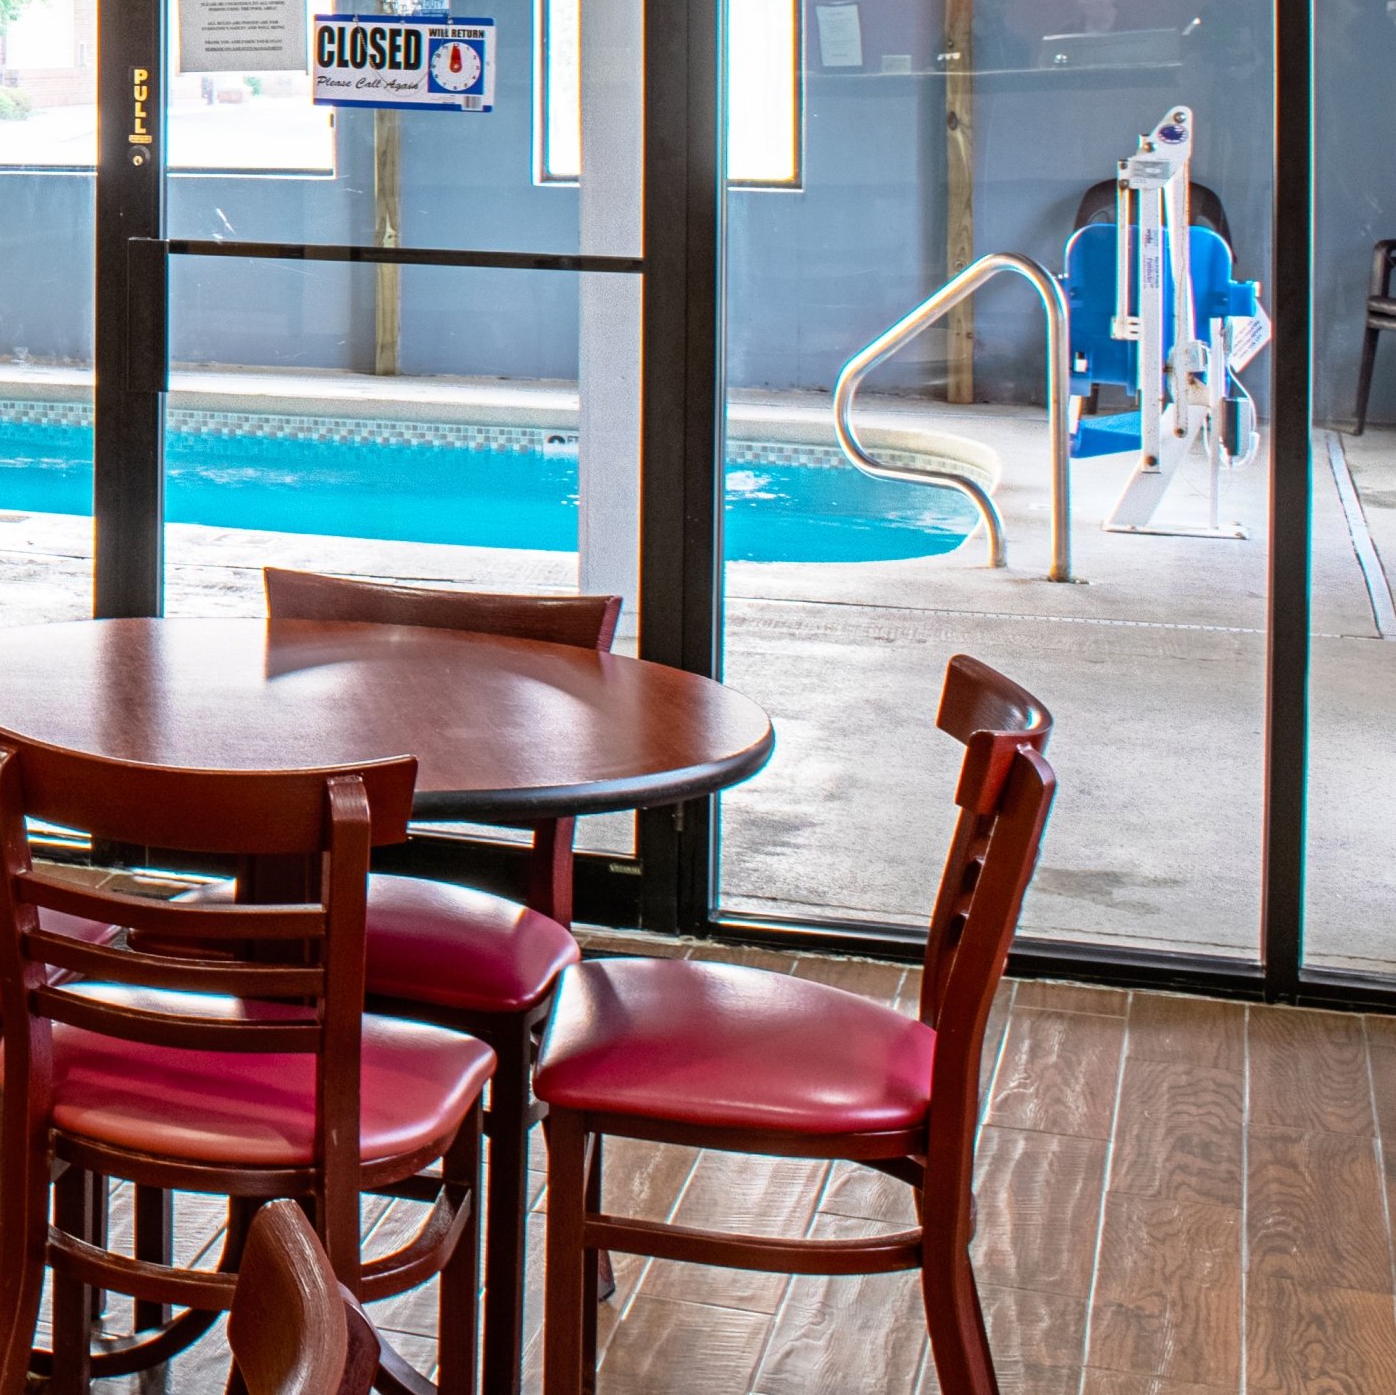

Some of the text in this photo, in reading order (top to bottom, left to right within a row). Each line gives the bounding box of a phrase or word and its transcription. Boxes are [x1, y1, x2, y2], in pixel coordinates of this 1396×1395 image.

[317, 25, 422, 70] CLOSED
[428, 28, 484, 38] WILL RETURN
[317, 76, 419, 92] Please Call Again
[134, 69, 148, 134] PULL
